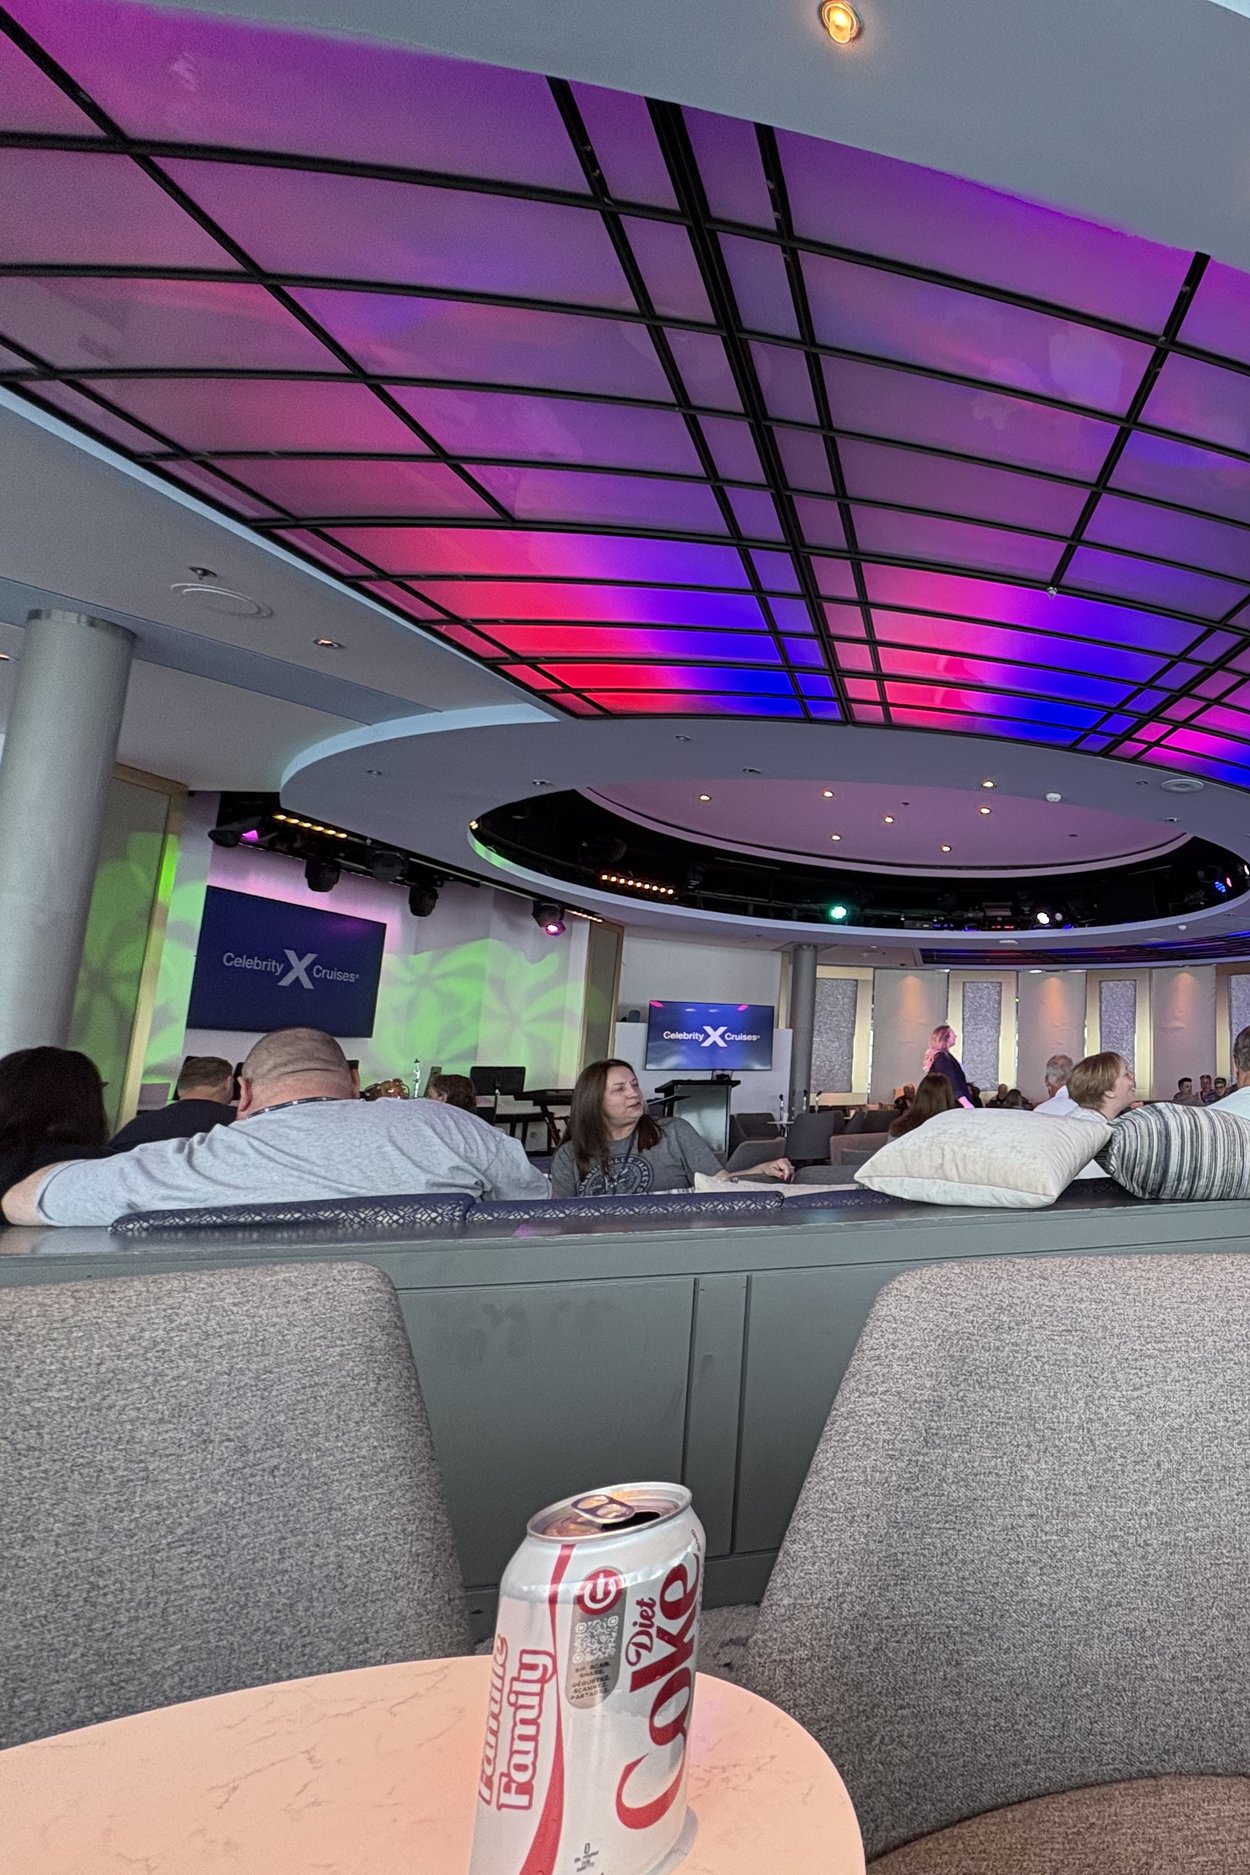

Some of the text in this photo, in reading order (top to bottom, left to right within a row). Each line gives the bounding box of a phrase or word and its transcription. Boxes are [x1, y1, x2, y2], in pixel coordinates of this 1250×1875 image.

[222, 952, 284, 976] Celebrity
[663, 1031, 704, 1041] Celebrity
[625, 1597, 656, 1667] Diet
[616, 1553, 700, 1830] Coke
[496, 1648, 557, 1811] Family
